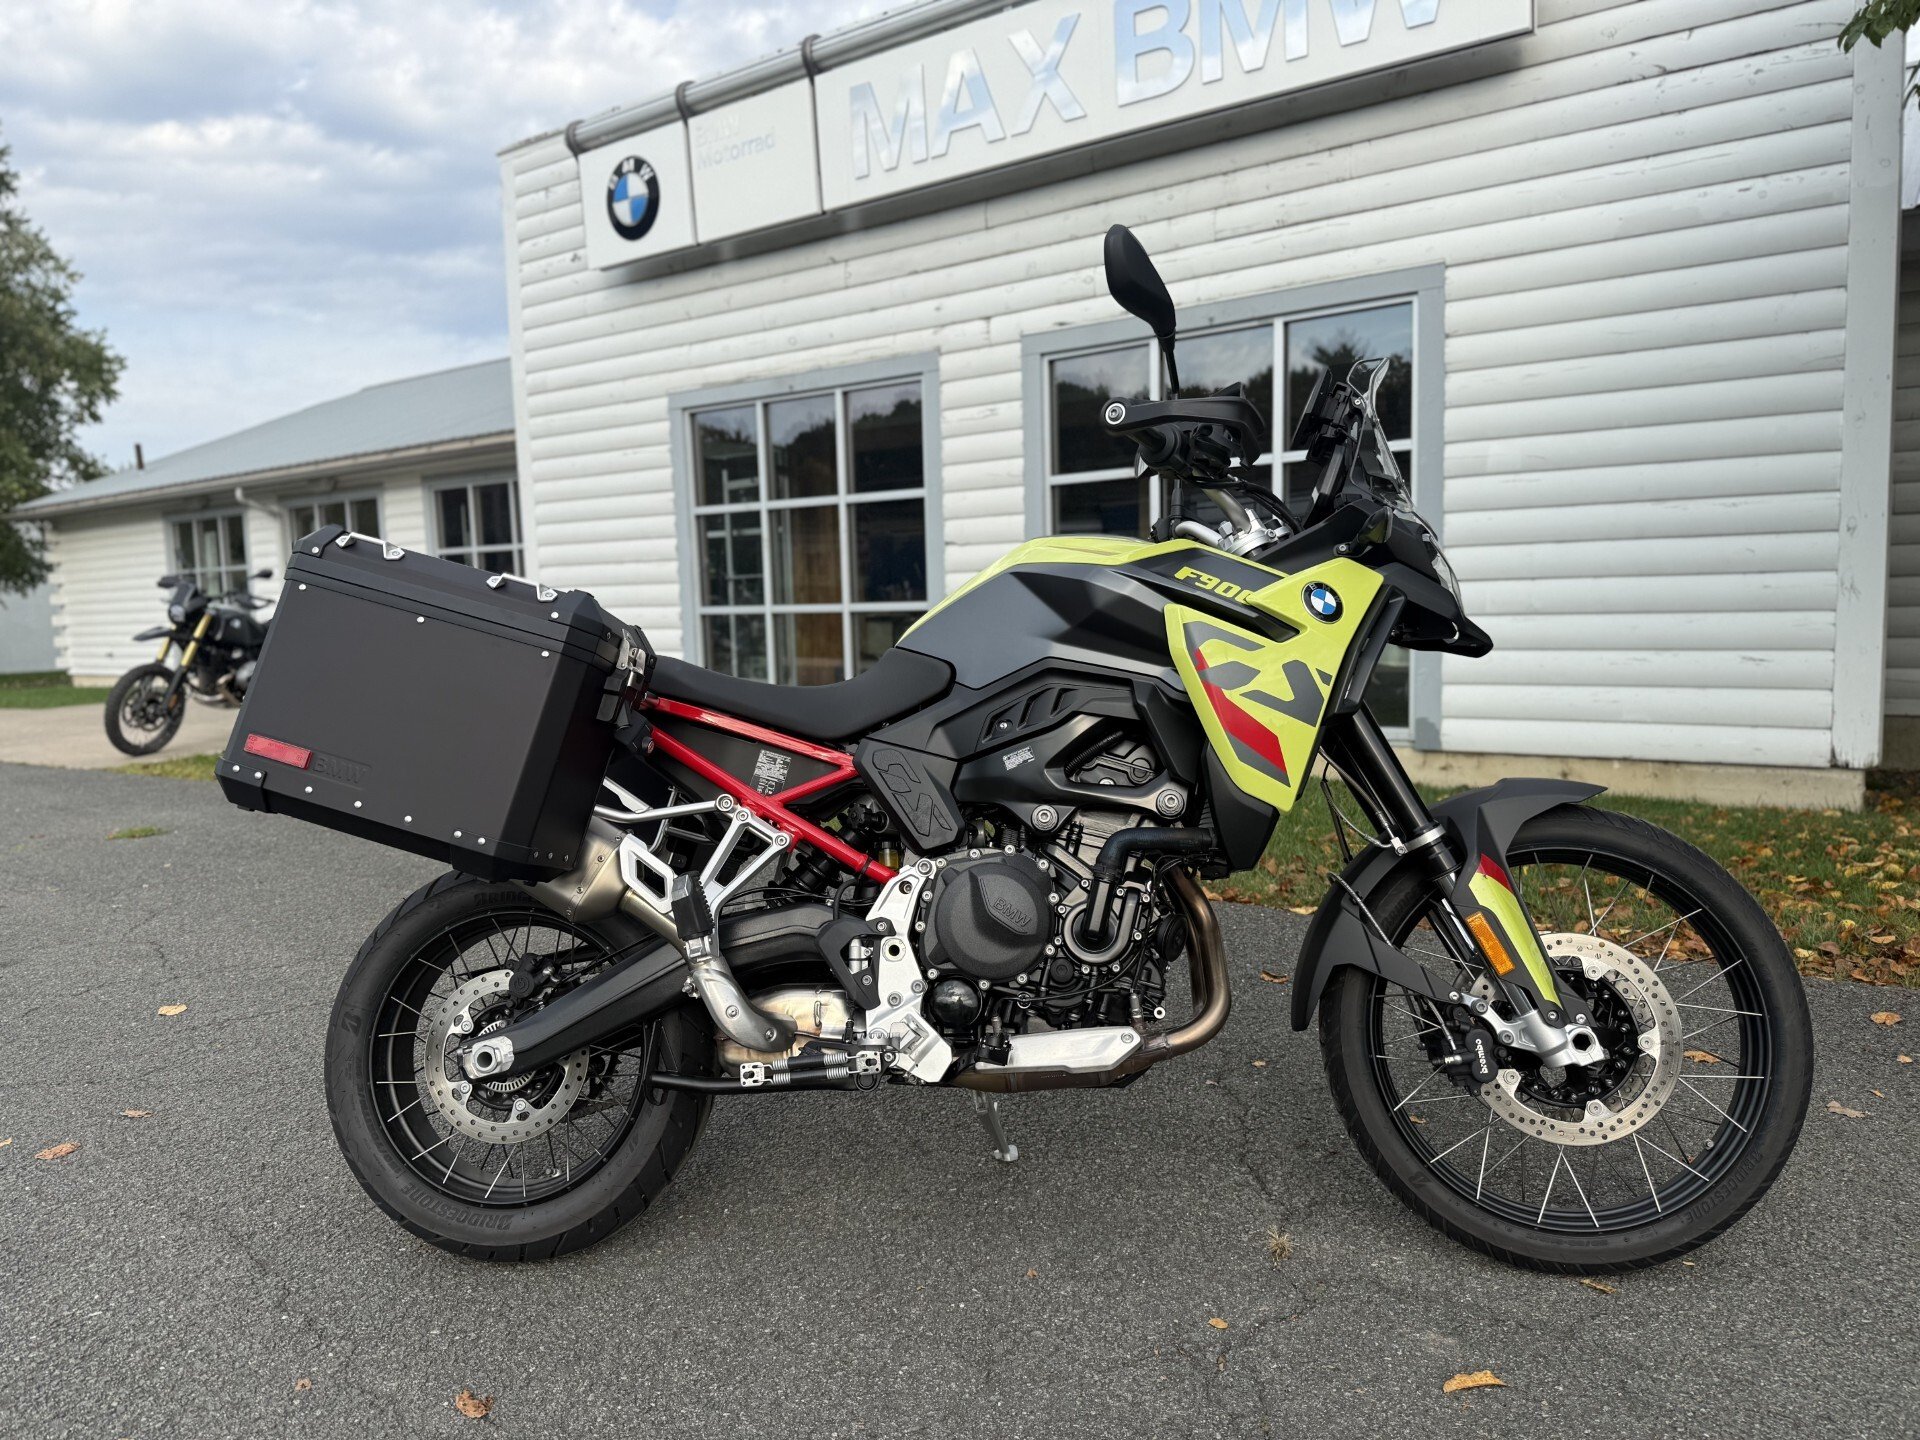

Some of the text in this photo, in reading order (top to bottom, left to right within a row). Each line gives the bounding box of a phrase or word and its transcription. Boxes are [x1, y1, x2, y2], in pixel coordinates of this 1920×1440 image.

[848, 12, 1087, 181] MAX
[697, 126, 777, 170] Motorrad
[609, 157, 655, 191] BMW
[313, 756, 367, 785] BMW
[993, 896, 1031, 927] BMW
[1475, 1038, 1489, 1075] brembo
[400, 1182, 513, 1232] BRIDGESTONE
[1686, 1151, 1764, 1225] BRIDGESTONE
